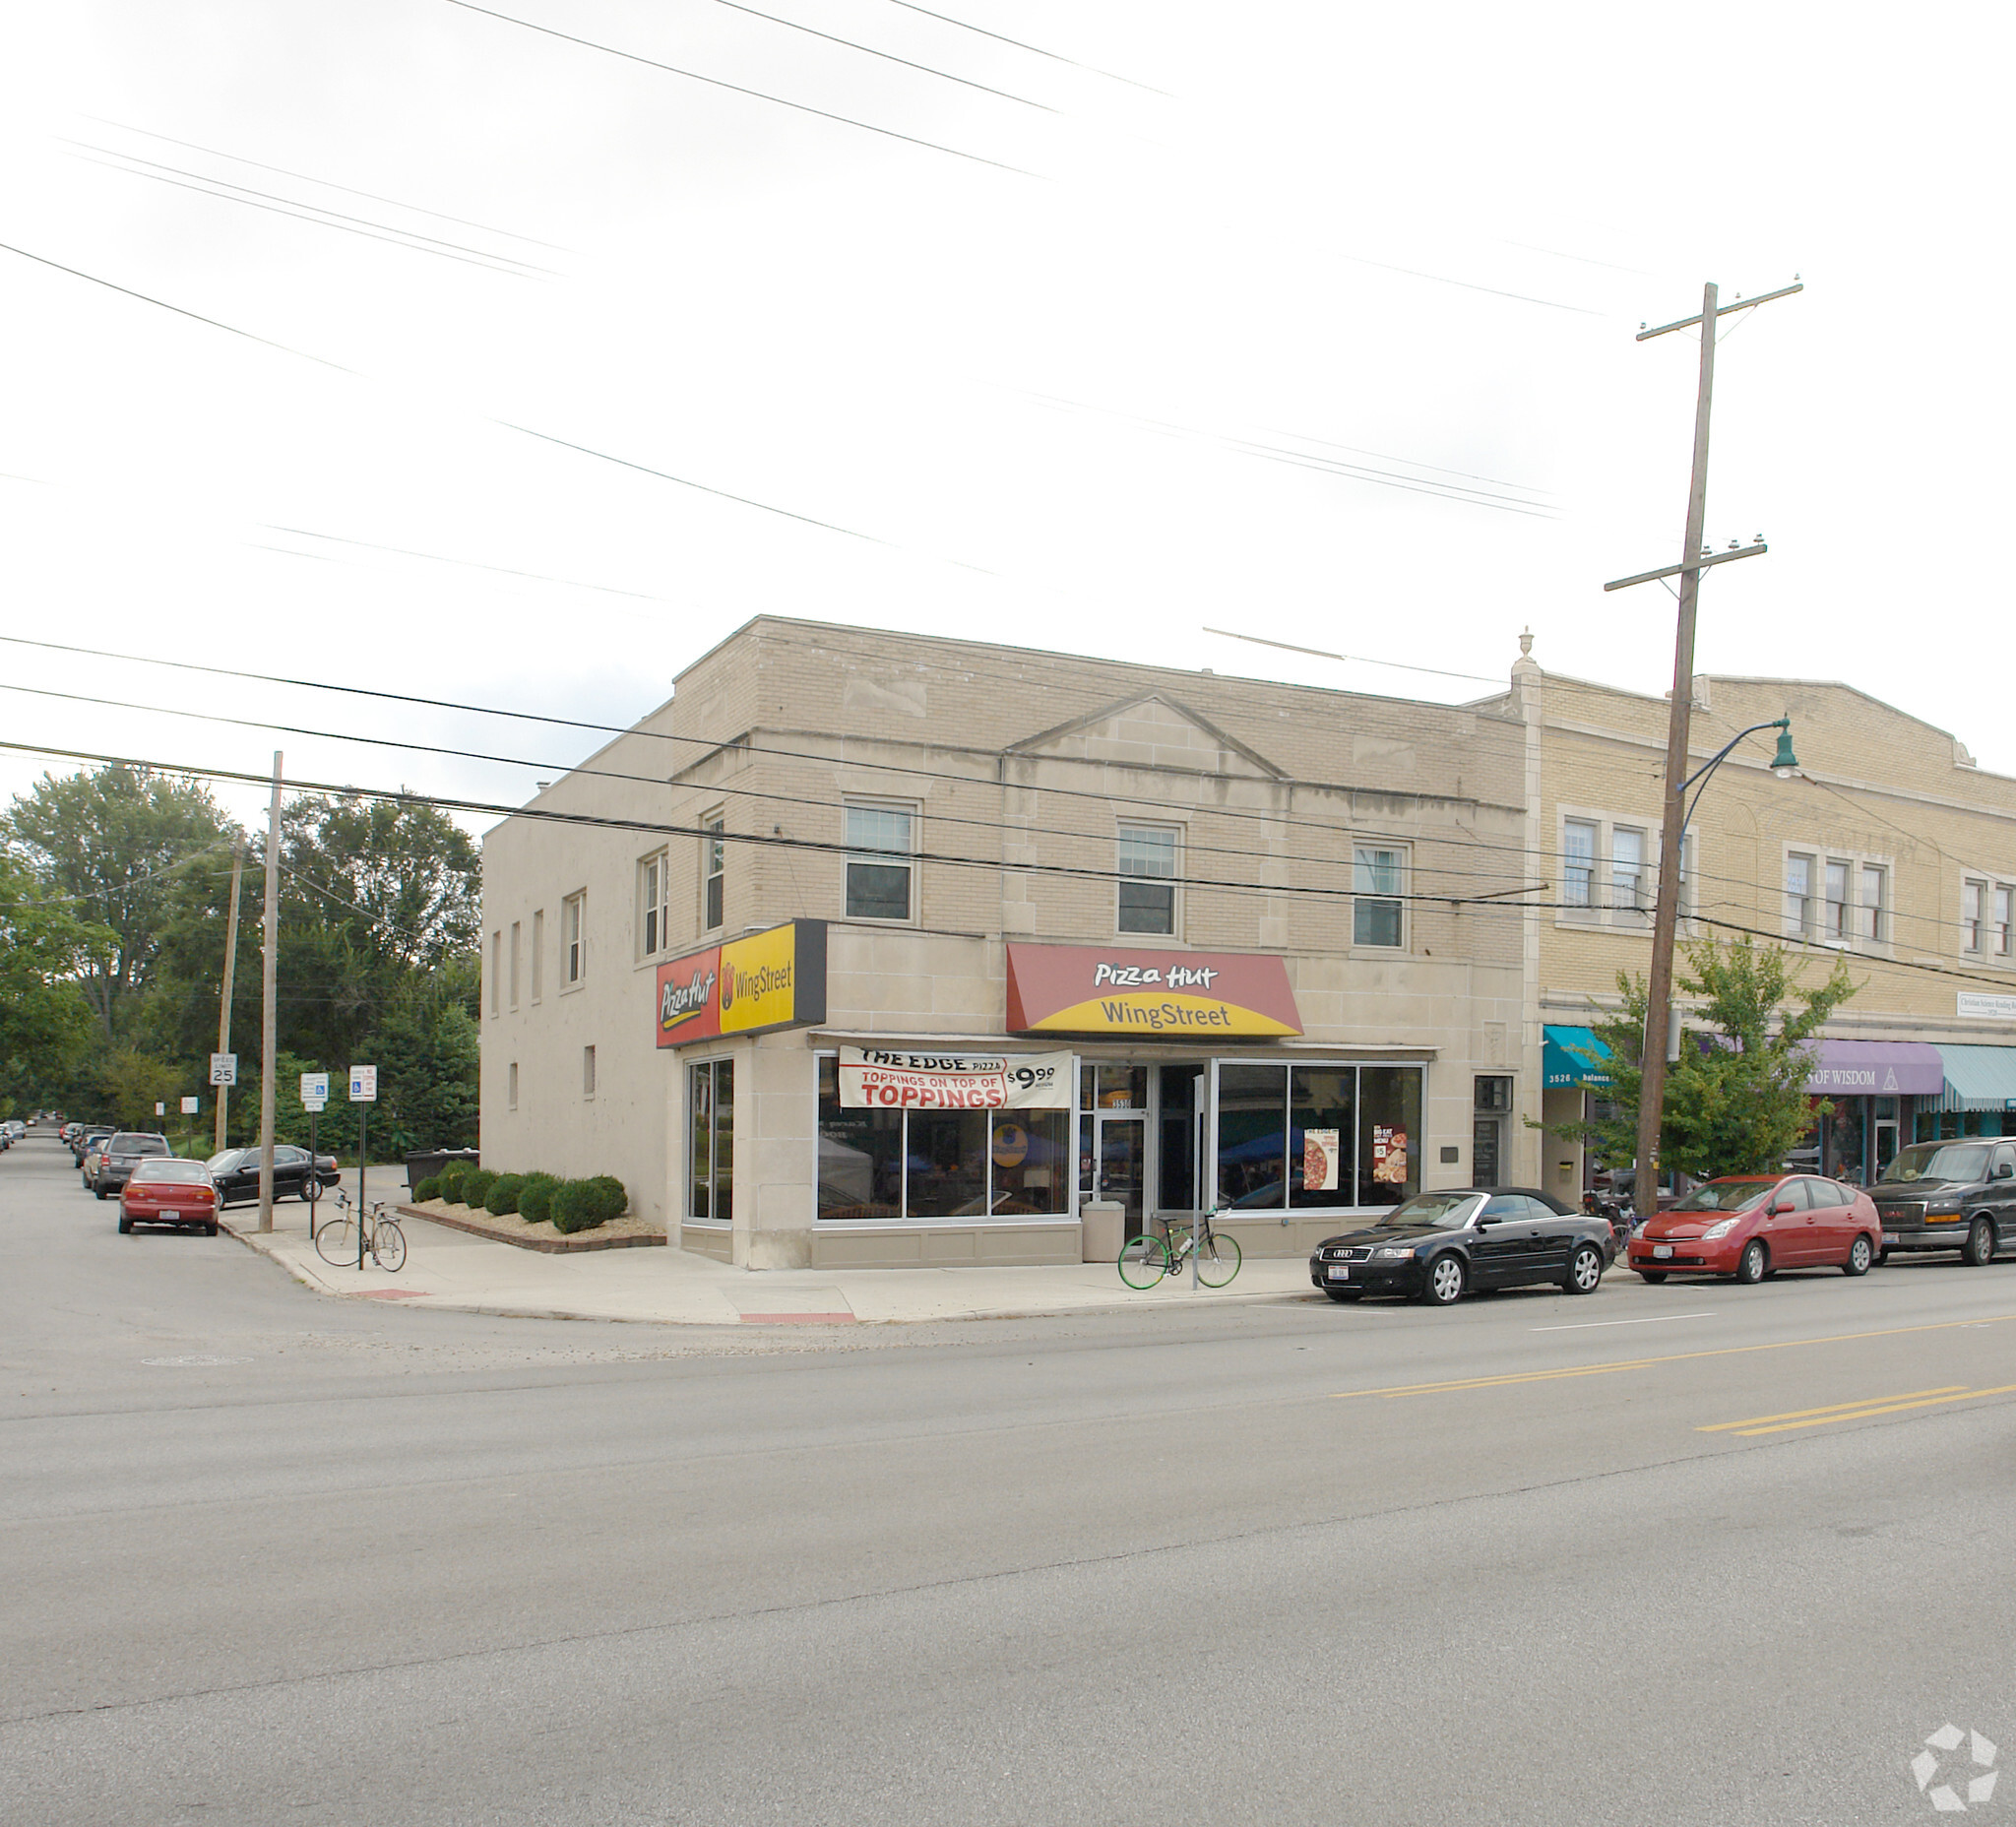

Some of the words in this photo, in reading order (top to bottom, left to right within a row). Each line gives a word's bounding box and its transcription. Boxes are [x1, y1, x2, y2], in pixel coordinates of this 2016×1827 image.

[735, 960, 791, 1001] WingStreet
[1094, 962, 1162, 987] Pizza
[1166, 965, 1219, 990] Hut
[661, 980, 688, 1024] Pizza
[688, 968, 716, 1007] Hut
[1101, 1001, 1231, 1030] WingStreet
[862, 1049, 904, 1066] THE
[909, 1055, 967, 1071] EDGE
[973, 1062, 1000, 1071] PIZZA
[213, 1069, 233, 1081] 25
[862, 1072, 925, 1087] TOPPINGS
[929, 1078, 948, 1088] ON
[948, 1078, 976, 1088] TOP
[981, 1078, 997, 1088] OF
[1814, 1069, 1830, 1085] OF
[1832, 1070, 1875, 1086] WISDOM
[861, 1084, 1002, 1108] TOPPINGS
